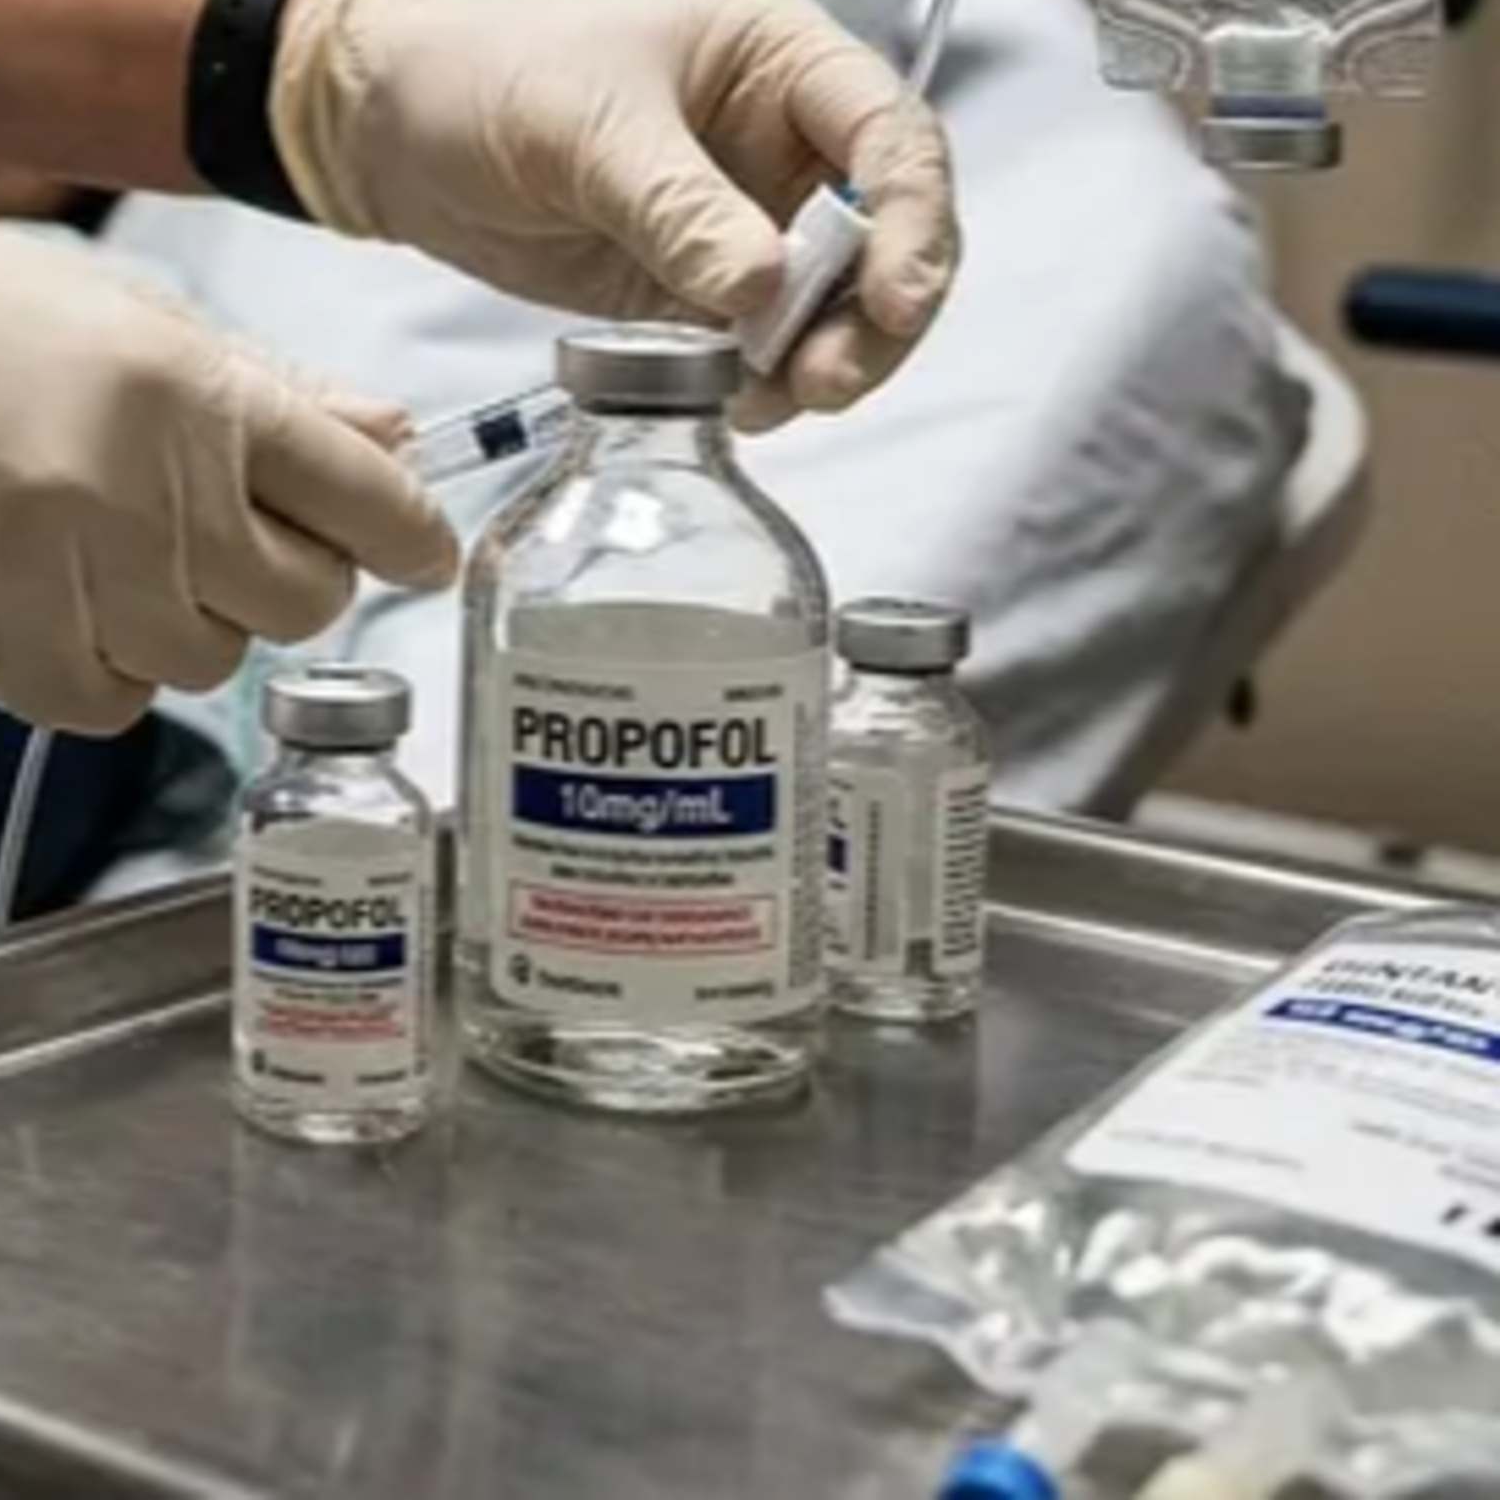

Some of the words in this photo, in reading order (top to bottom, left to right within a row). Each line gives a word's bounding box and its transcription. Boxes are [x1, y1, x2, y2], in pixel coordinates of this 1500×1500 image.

[513, 706, 777, 769] PROPOFOL
[559, 781, 734, 831] 10mg/mL
[251, 883, 409, 929] PROPOFOL
